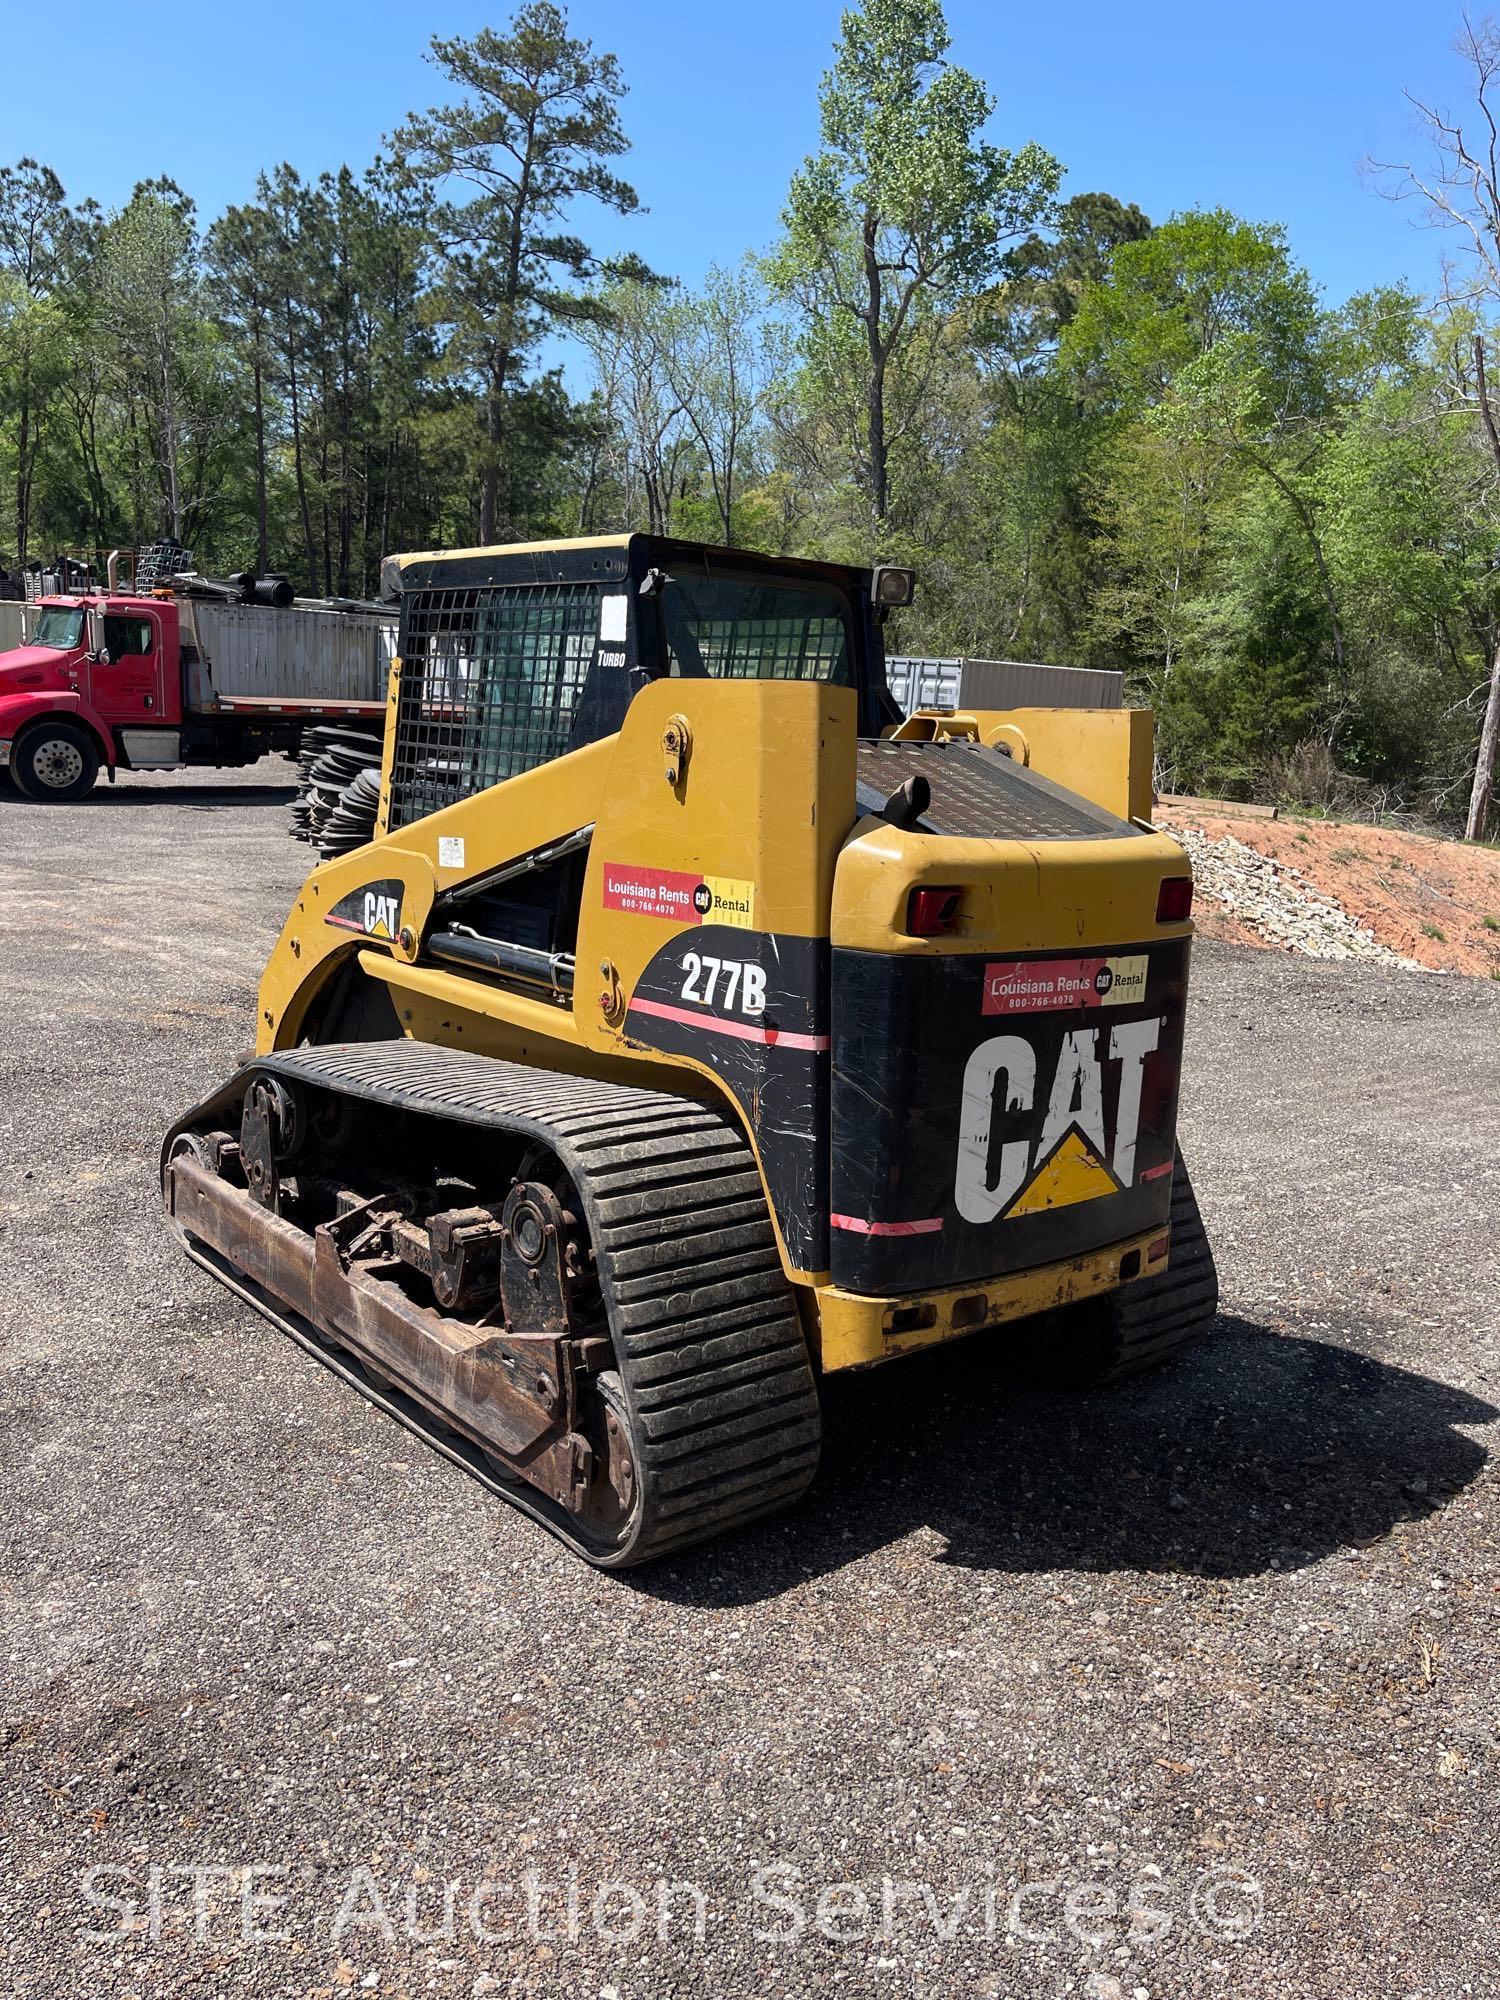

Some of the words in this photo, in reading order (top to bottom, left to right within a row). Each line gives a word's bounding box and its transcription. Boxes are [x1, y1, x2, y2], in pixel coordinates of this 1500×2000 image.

[597, 649, 626, 668] TURBO
[608, 878, 656, 898] Louisiana
[659, 886, 690, 904] Rents
[695, 891, 710, 909] CAT
[622, 898, 675, 914] 800-766-4070
[714, 895, 749, 912] Rental
[364, 891, 399, 940] CAT
[680, 952, 767, 1016] 277B
[991, 979, 1053, 996] Louisiana
[1057, 976, 1090, 991] Rents
[1096, 975, 1110, 987] CAT
[1114, 973, 1143, 986] Rental
[1009, 995, 1073, 1008] 800-766-4070
[954, 1017, 1161, 1224] CAT
